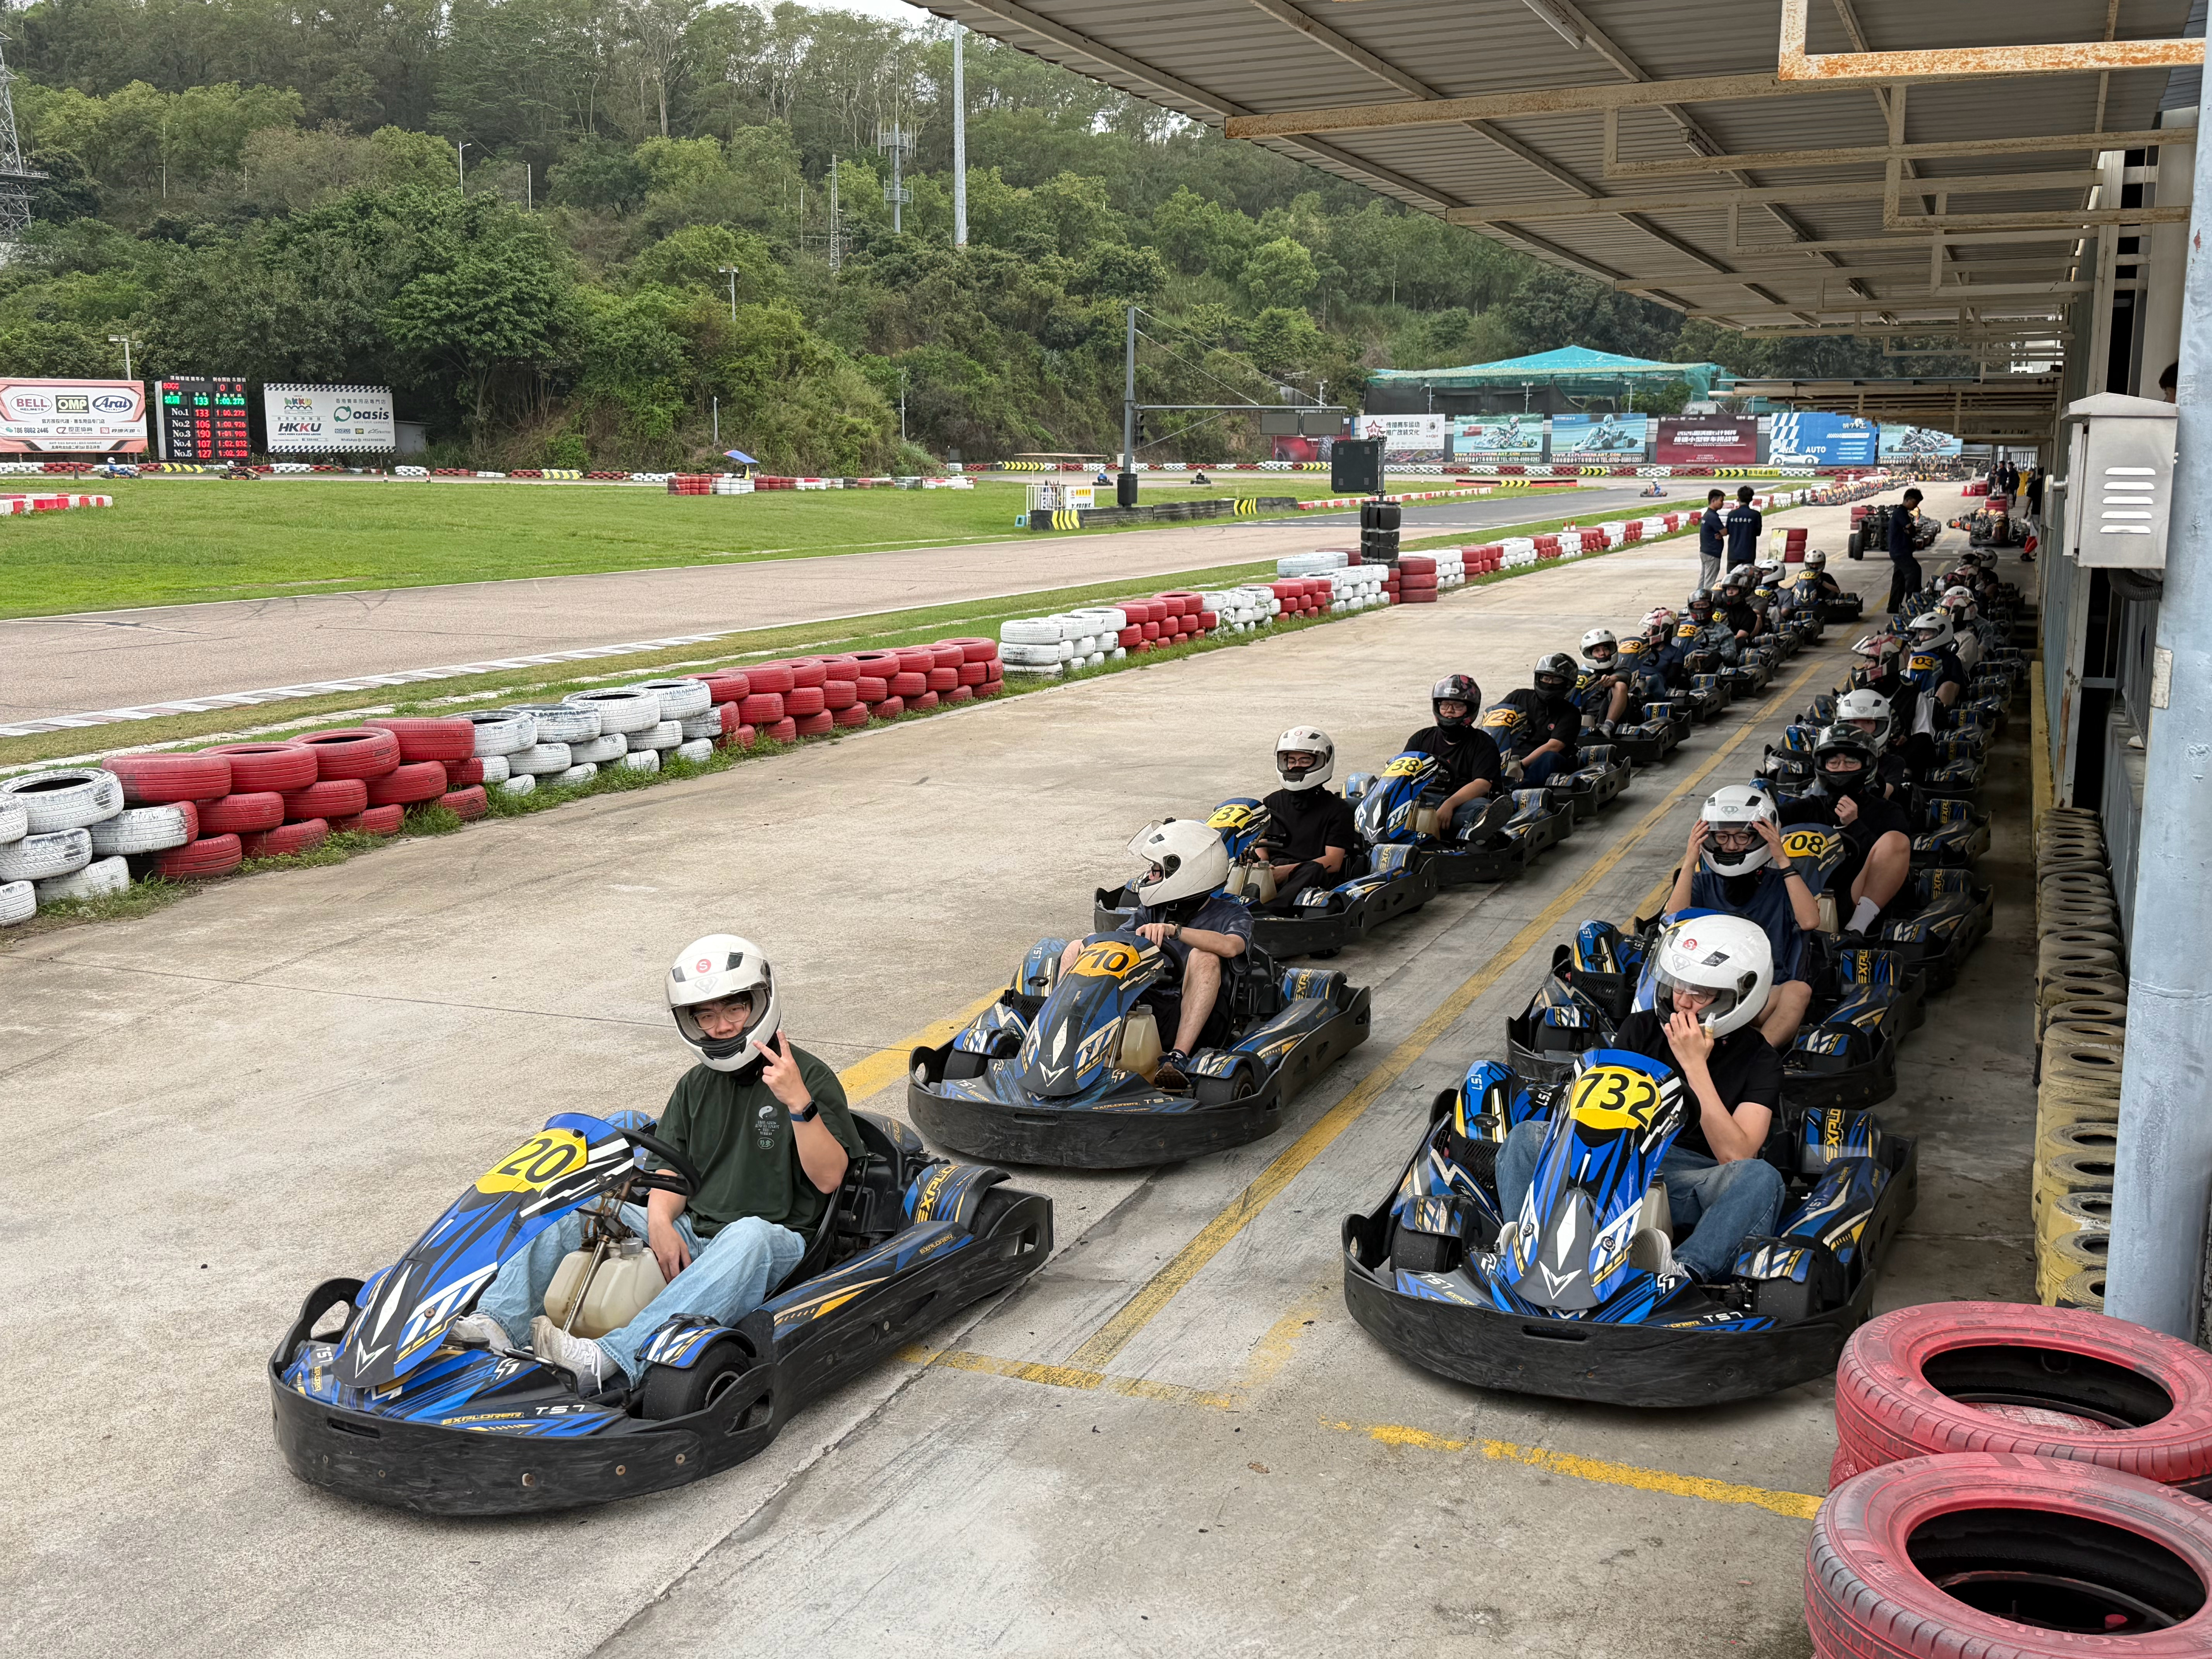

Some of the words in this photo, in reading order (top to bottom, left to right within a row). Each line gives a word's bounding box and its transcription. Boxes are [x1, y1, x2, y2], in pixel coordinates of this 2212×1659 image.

[17, 398, 47, 407] BELL
[58, 400, 87, 409] OMP
[96, 397, 128, 409] Arai
[195, 409, 210, 417] 133
[353, 407, 389, 420] oasis
[278, 423, 321, 432] HKKU
[1386, 760, 1419, 773] 38
[699, 961, 708, 970] S
[1071, 949, 1129, 972] 710
[957, 1080, 976, 1089] TS7
[1471, 1074, 1482, 1090] TS7
[1575, 1073, 1657, 1123] 732
[919, 1234, 954, 1254] EXPLORER
[1420, 1274, 1455, 1289] TS7
[1703, 1312, 1743, 1322] TS7
[1869, 1308, 1921, 1341] KUMHO
[316, 1346, 333, 1363] TS7
[536, 1405, 585, 1415] TS7
[442, 1412, 523, 1425] EXPLORER
